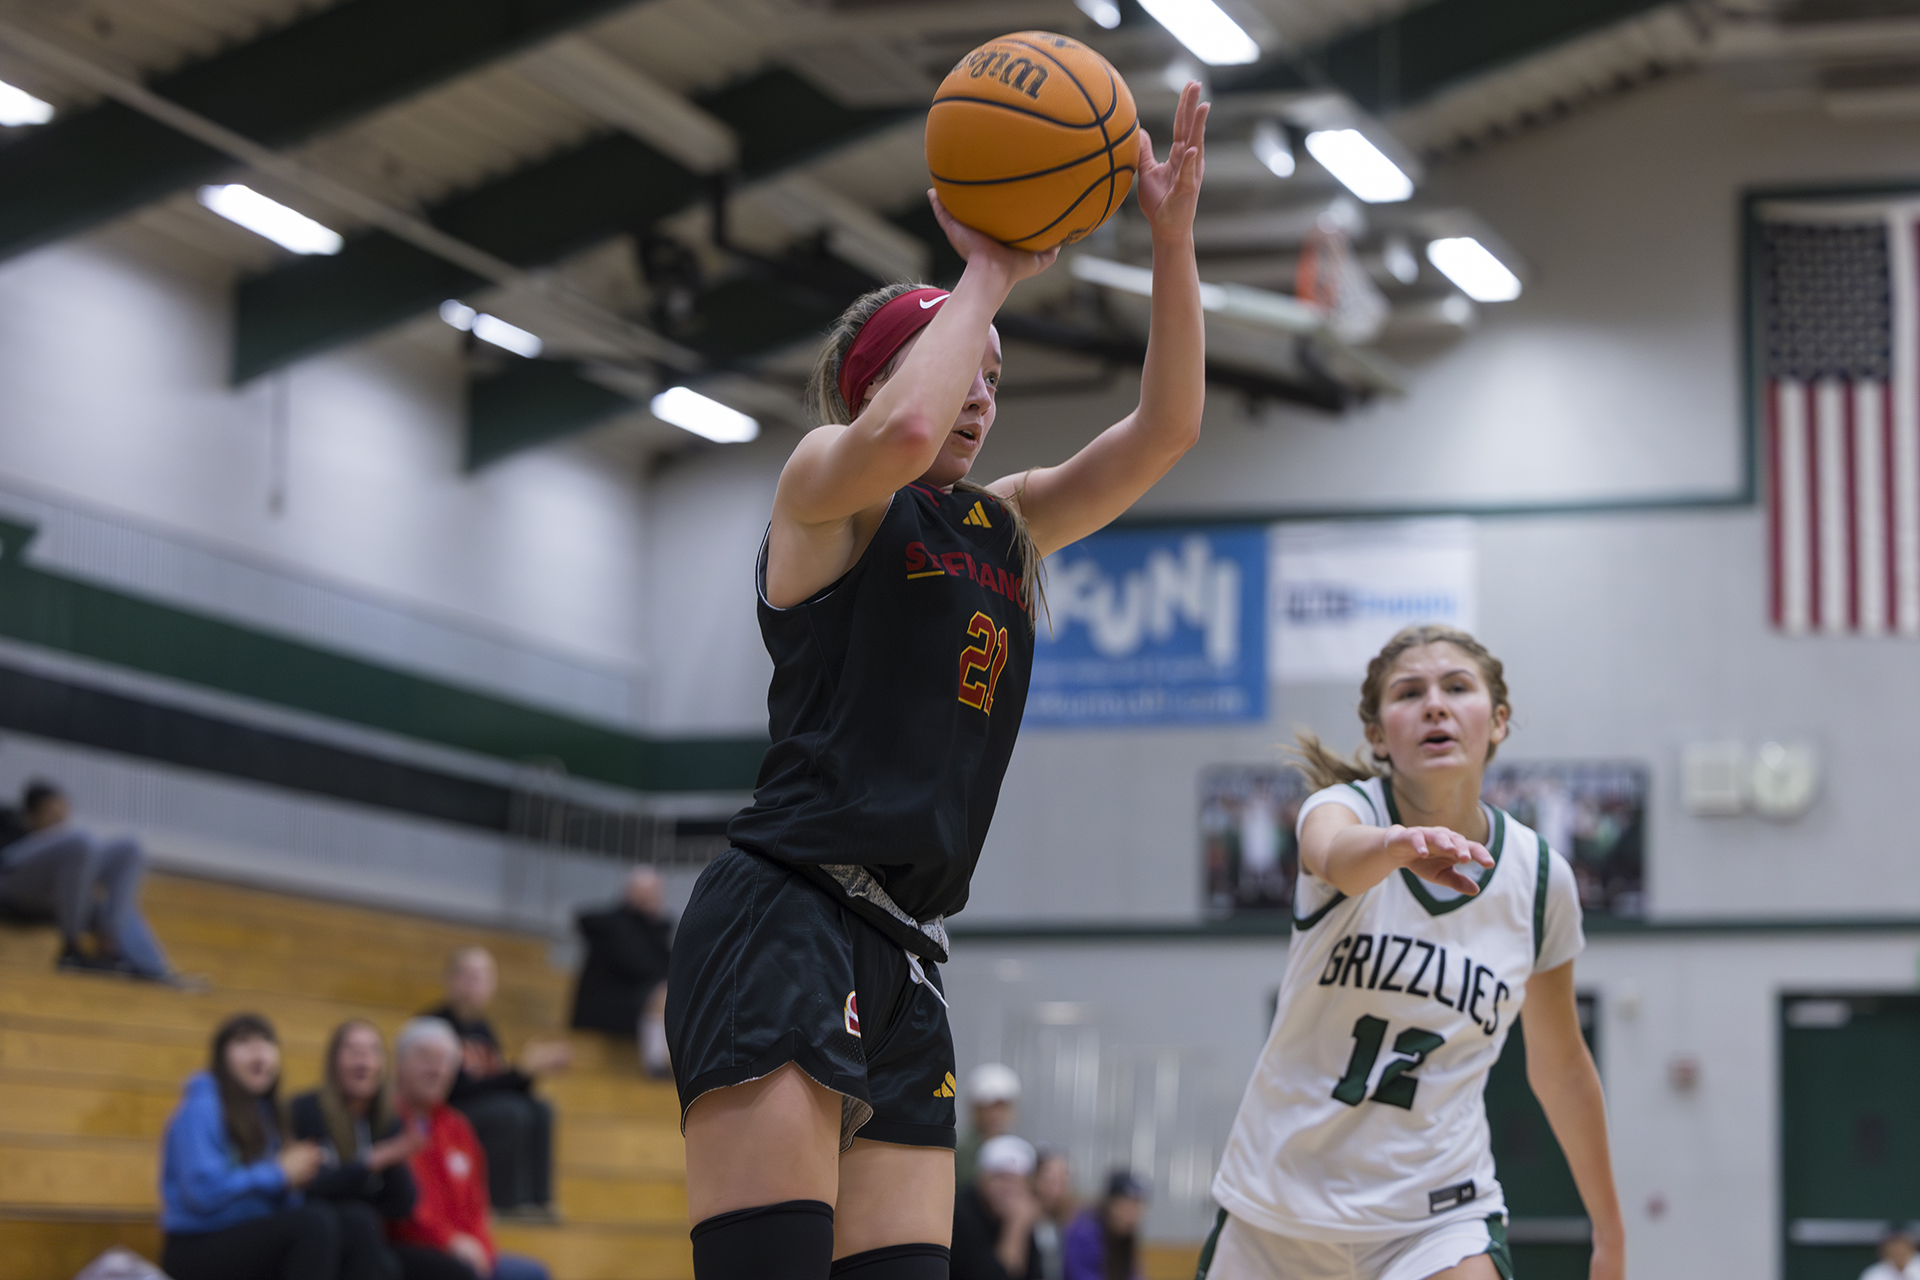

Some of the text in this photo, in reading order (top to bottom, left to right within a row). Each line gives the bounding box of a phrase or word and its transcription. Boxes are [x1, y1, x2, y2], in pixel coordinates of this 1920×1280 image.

[958, 611, 1008, 717] 21
[1318, 934, 1509, 1036] GRIZZLIES
[1331, 1013, 1446, 1111] 12
